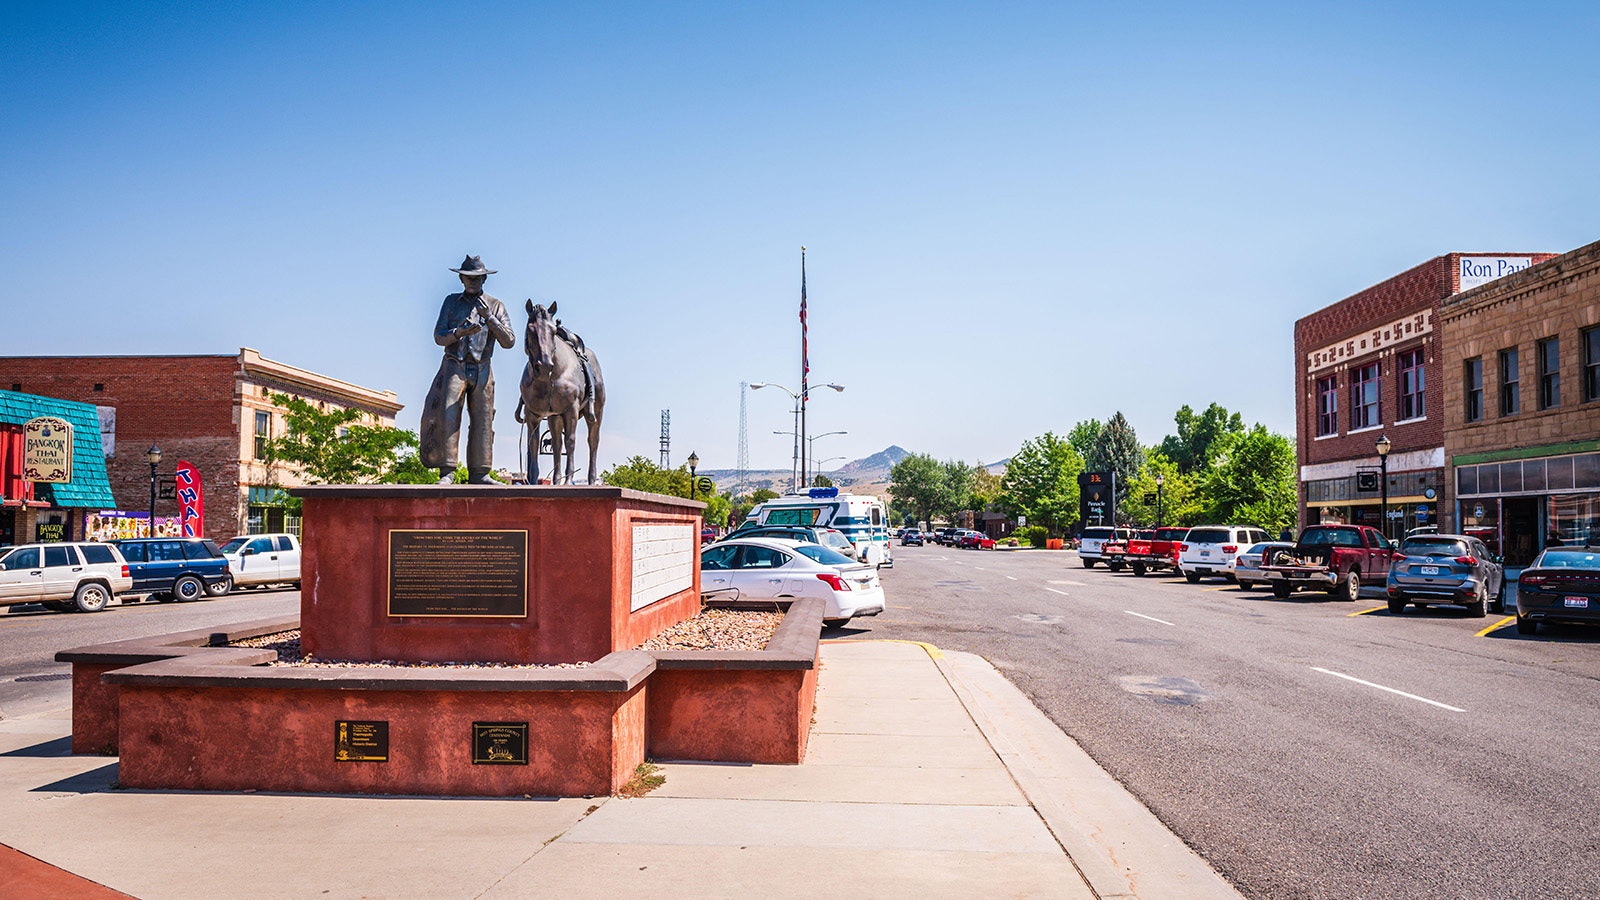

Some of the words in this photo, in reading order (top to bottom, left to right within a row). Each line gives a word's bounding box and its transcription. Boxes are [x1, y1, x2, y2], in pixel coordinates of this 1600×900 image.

[1462, 259, 1492, 277] Ron
[27, 439, 65, 453] BANGKOK
[27, 457, 64, 465] RESTAURANT
[176, 469, 200, 538] THAI
[40, 524, 64, 536] BANGKOK
